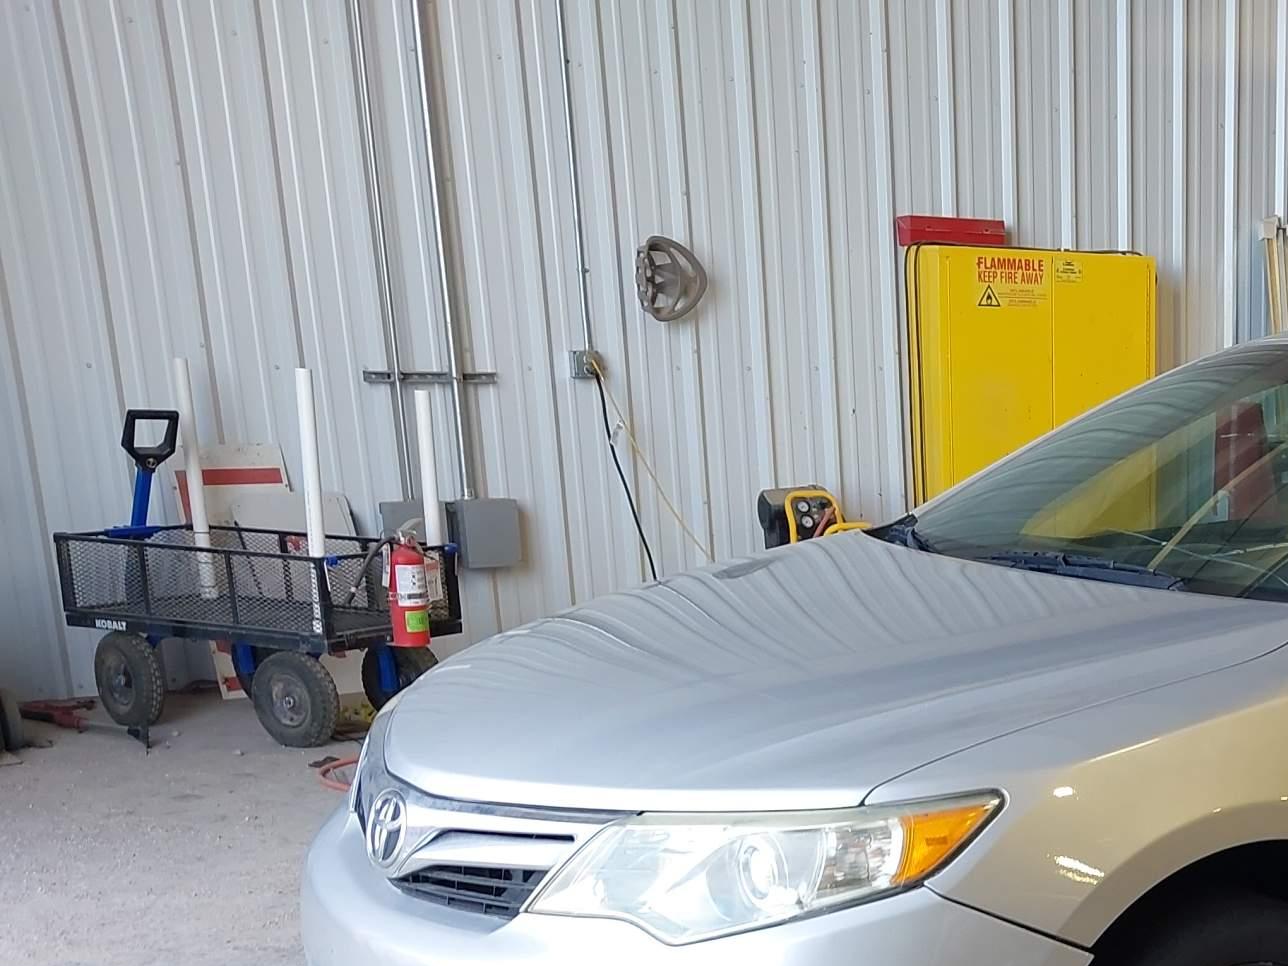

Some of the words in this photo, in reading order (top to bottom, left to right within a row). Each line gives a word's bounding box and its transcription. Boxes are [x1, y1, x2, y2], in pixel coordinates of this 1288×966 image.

[976, 256, 1044, 272] FLAMMABLE
[978, 270, 998, 283] KEEP
[1000, 271, 1018, 284] FIRE
[1020, 272, 1044, 285] AWAY
[95, 619, 127, 630] KOBALT
